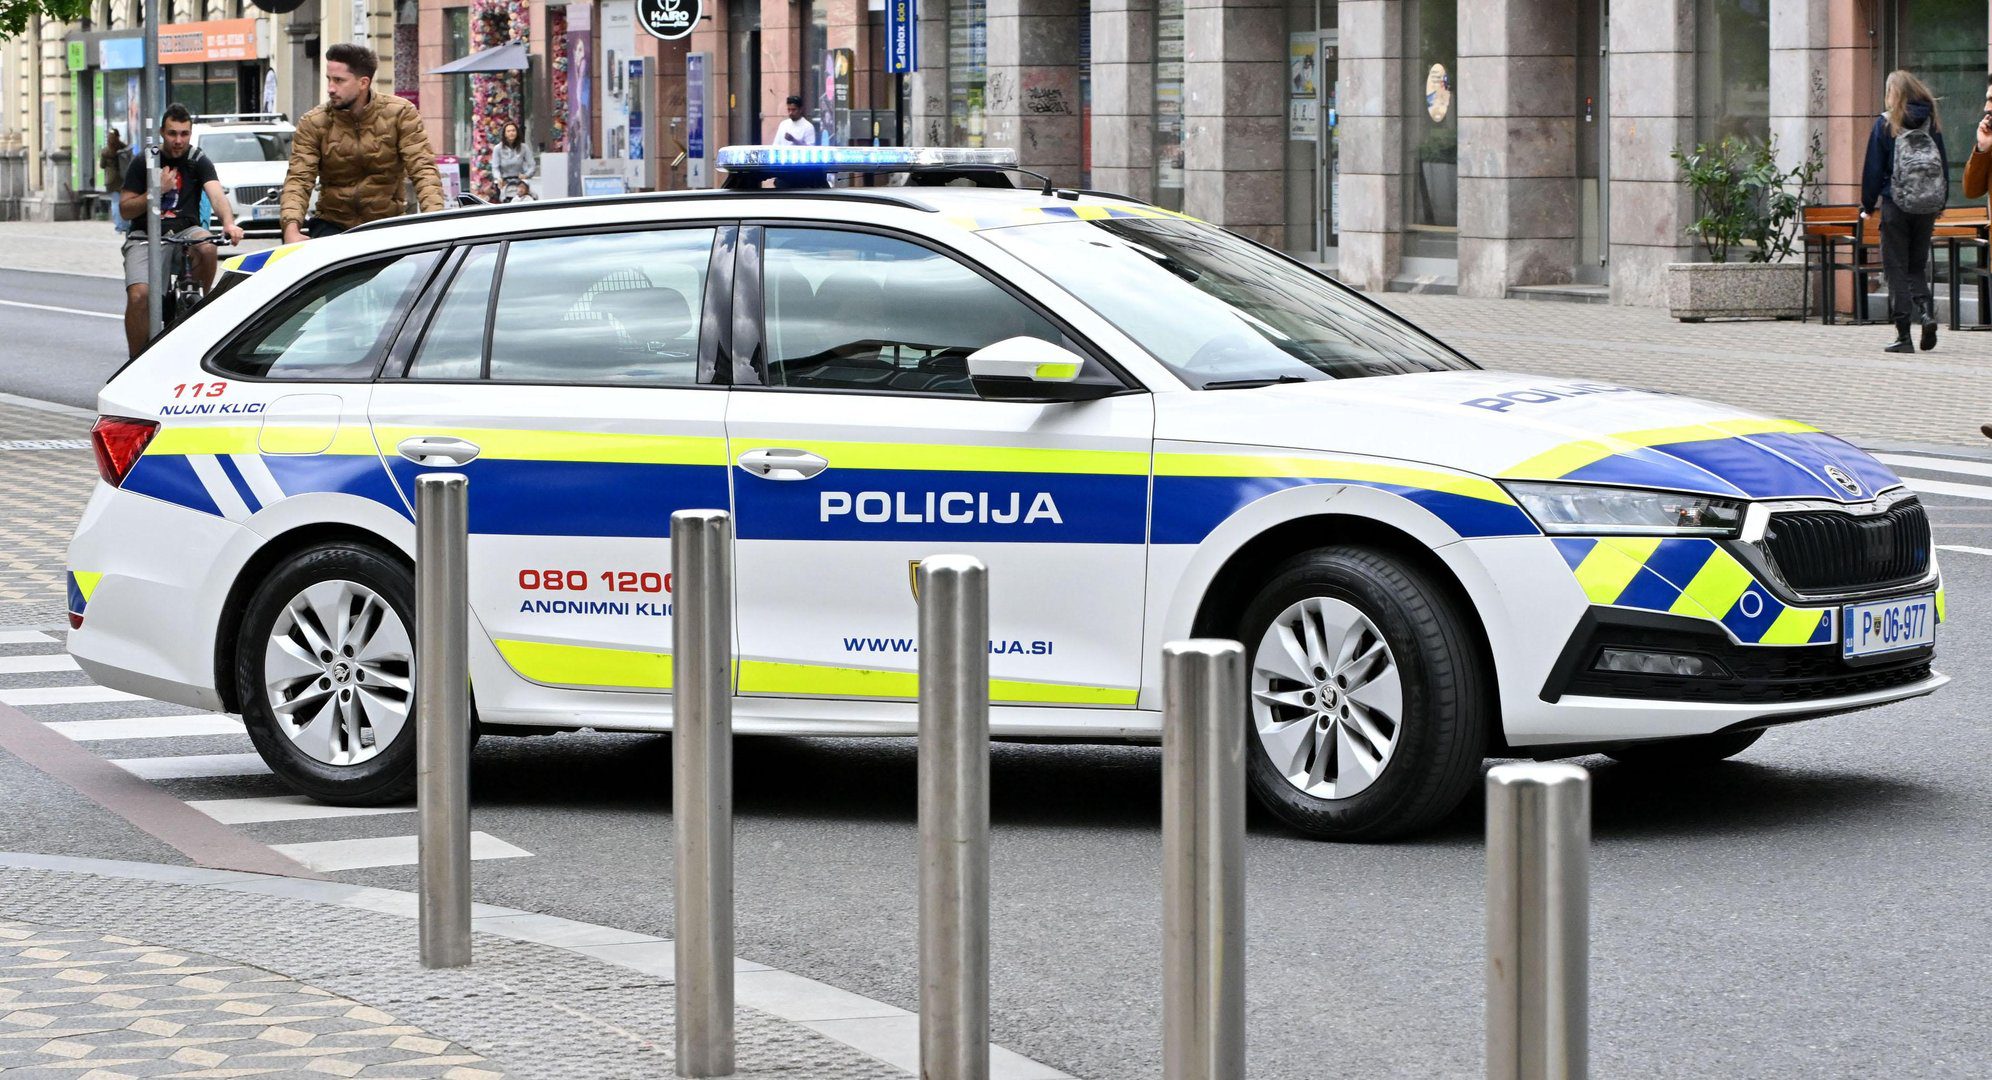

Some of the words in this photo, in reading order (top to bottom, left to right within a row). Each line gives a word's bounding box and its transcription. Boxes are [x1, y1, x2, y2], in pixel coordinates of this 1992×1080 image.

[896, 26, 906, 54] Relax
[174, 382, 227, 398] 113
[160, 404, 215, 415] NUJNI
[219, 403, 266, 414] KLICI
[820, 491, 1063, 524] POLICIJA
[519, 569, 588, 591] 080
[520, 600, 629, 616] ANONIMNI
[636, 603, 672, 616] KLI
[1863, 611, 1873, 646] P
[1884, 603, 1926, 643] 06-977
[844, 638, 1053, 655] WWW.IJA.SI
